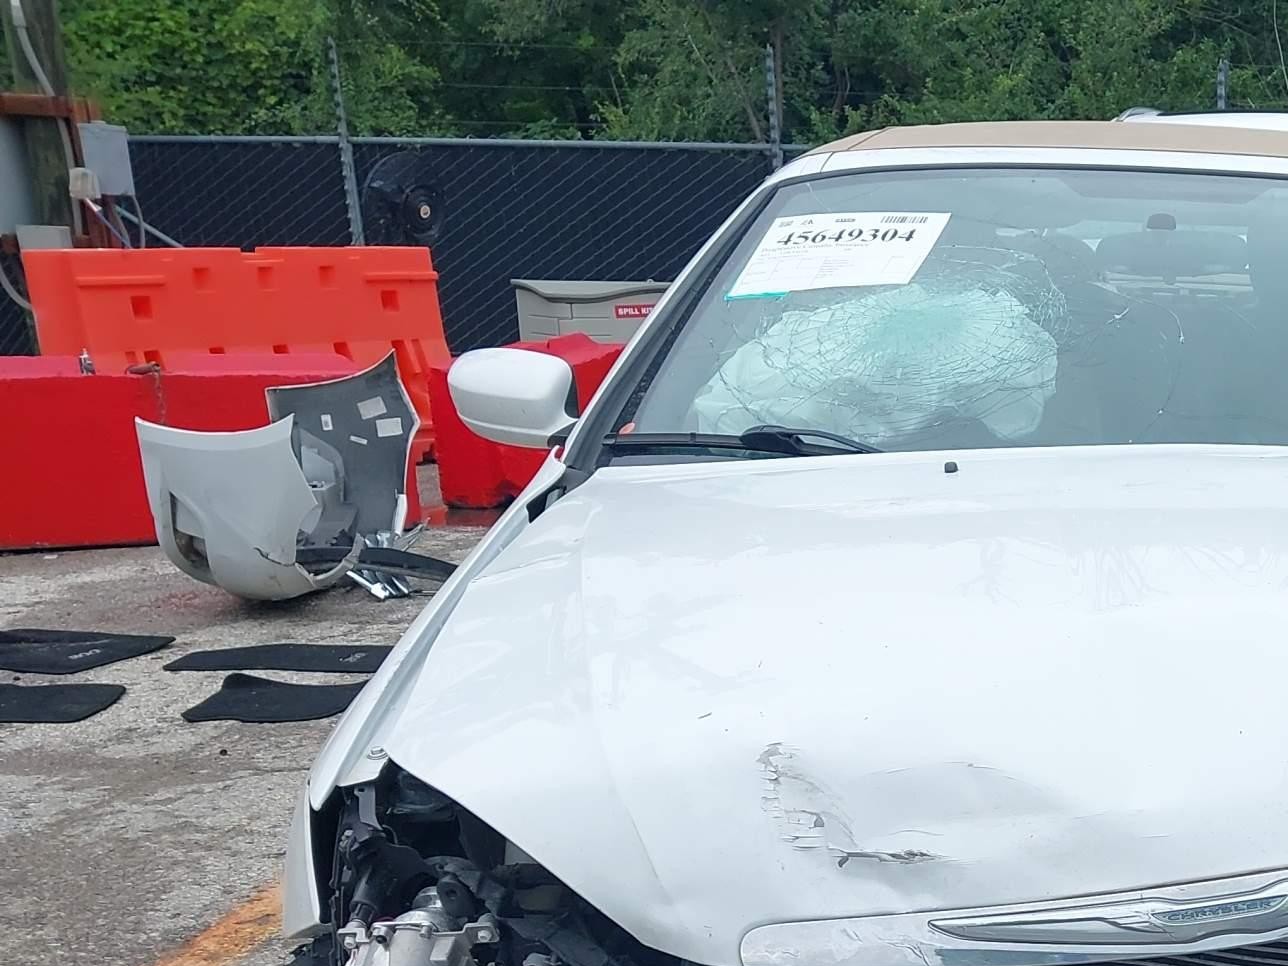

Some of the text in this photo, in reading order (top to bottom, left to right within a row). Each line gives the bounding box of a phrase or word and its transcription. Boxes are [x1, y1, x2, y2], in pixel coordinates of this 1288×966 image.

[777, 227, 917, 246] 45649304
[618, 307, 640, 315] SPILL
[1167, 900, 1272, 921] CHRYSLER
